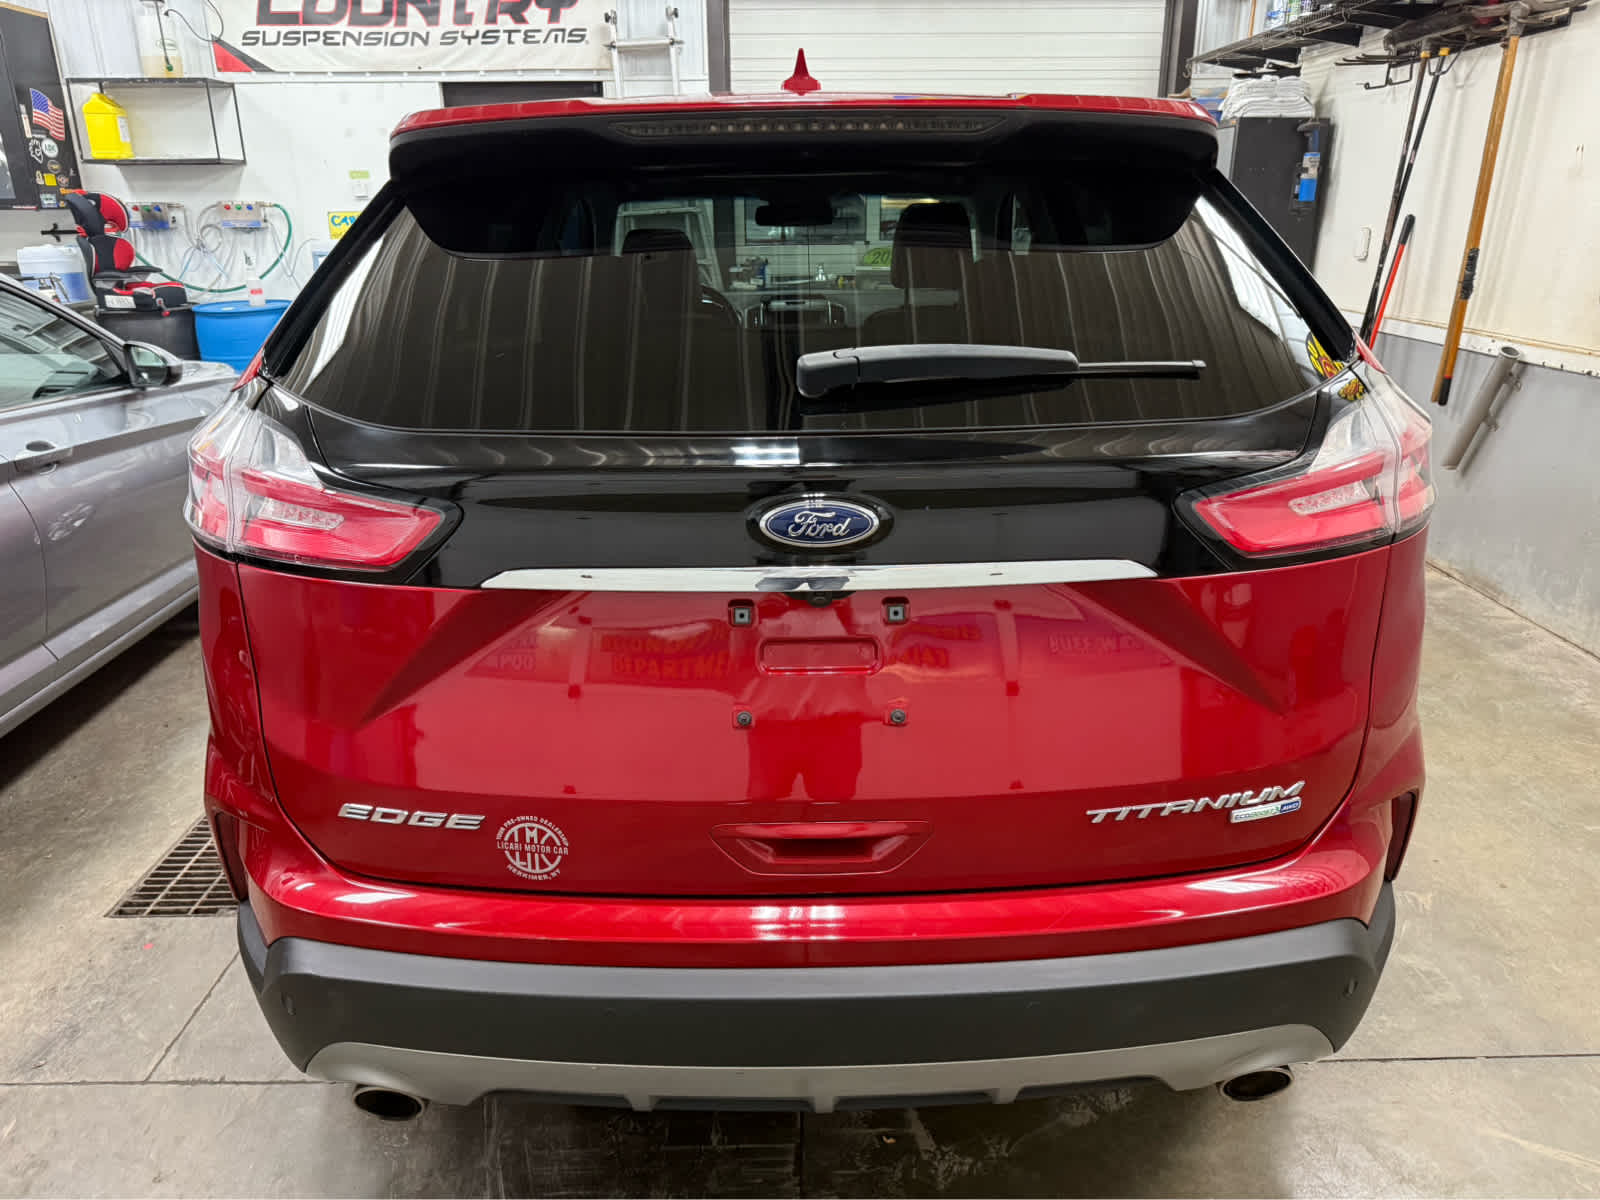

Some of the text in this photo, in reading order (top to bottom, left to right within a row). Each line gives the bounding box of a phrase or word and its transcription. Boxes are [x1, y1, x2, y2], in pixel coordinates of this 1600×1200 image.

[241, 28, 587, 46] SUSPENSION SYSTEMS
[788, 511, 851, 537] Ford
[1086, 780, 1306, 824] TITANIUM
[337, 803, 486, 830] EDGE
[496, 841, 569, 855] LICARI MOTOR CAR
